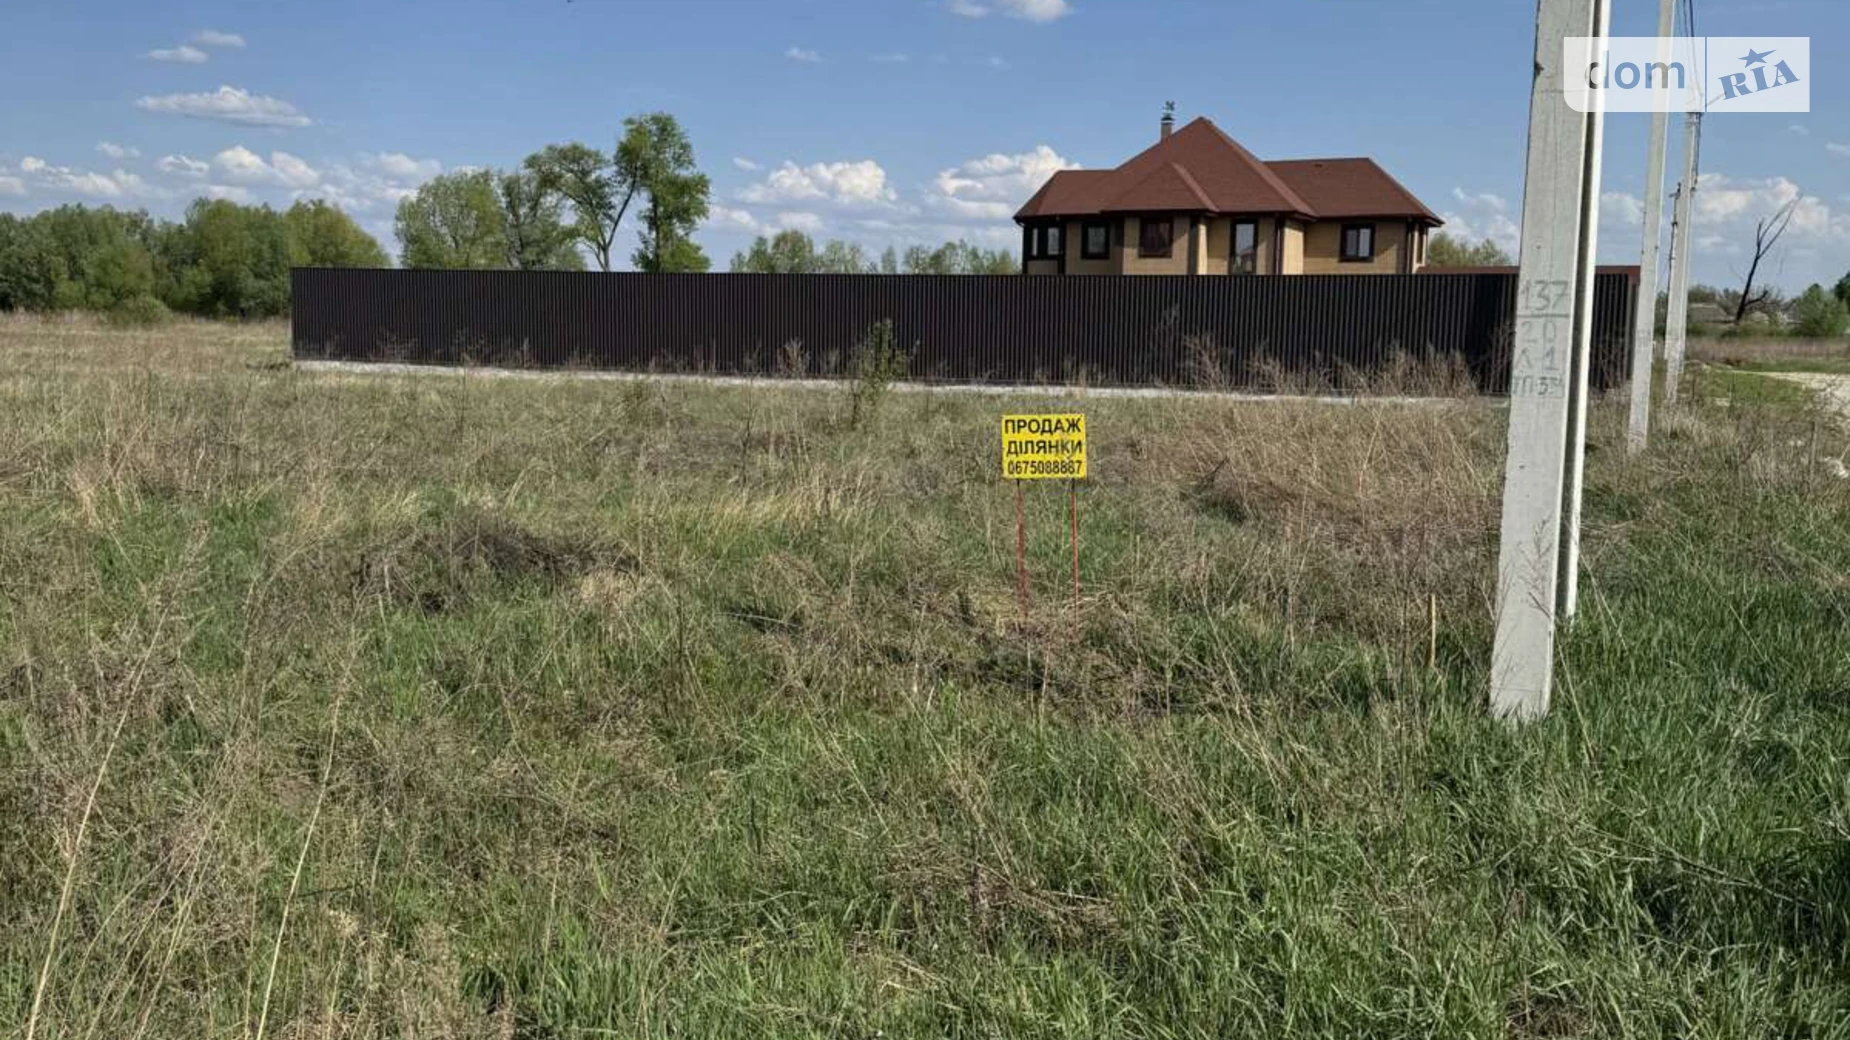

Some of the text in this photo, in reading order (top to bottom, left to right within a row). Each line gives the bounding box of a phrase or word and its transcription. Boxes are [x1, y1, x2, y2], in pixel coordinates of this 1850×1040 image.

[1521, 280, 1569, 311] 137
[1004, 418, 1082, 435] ПРОДАЖ
[1006, 440, 1083, 457] ДІЛЯНКИ
